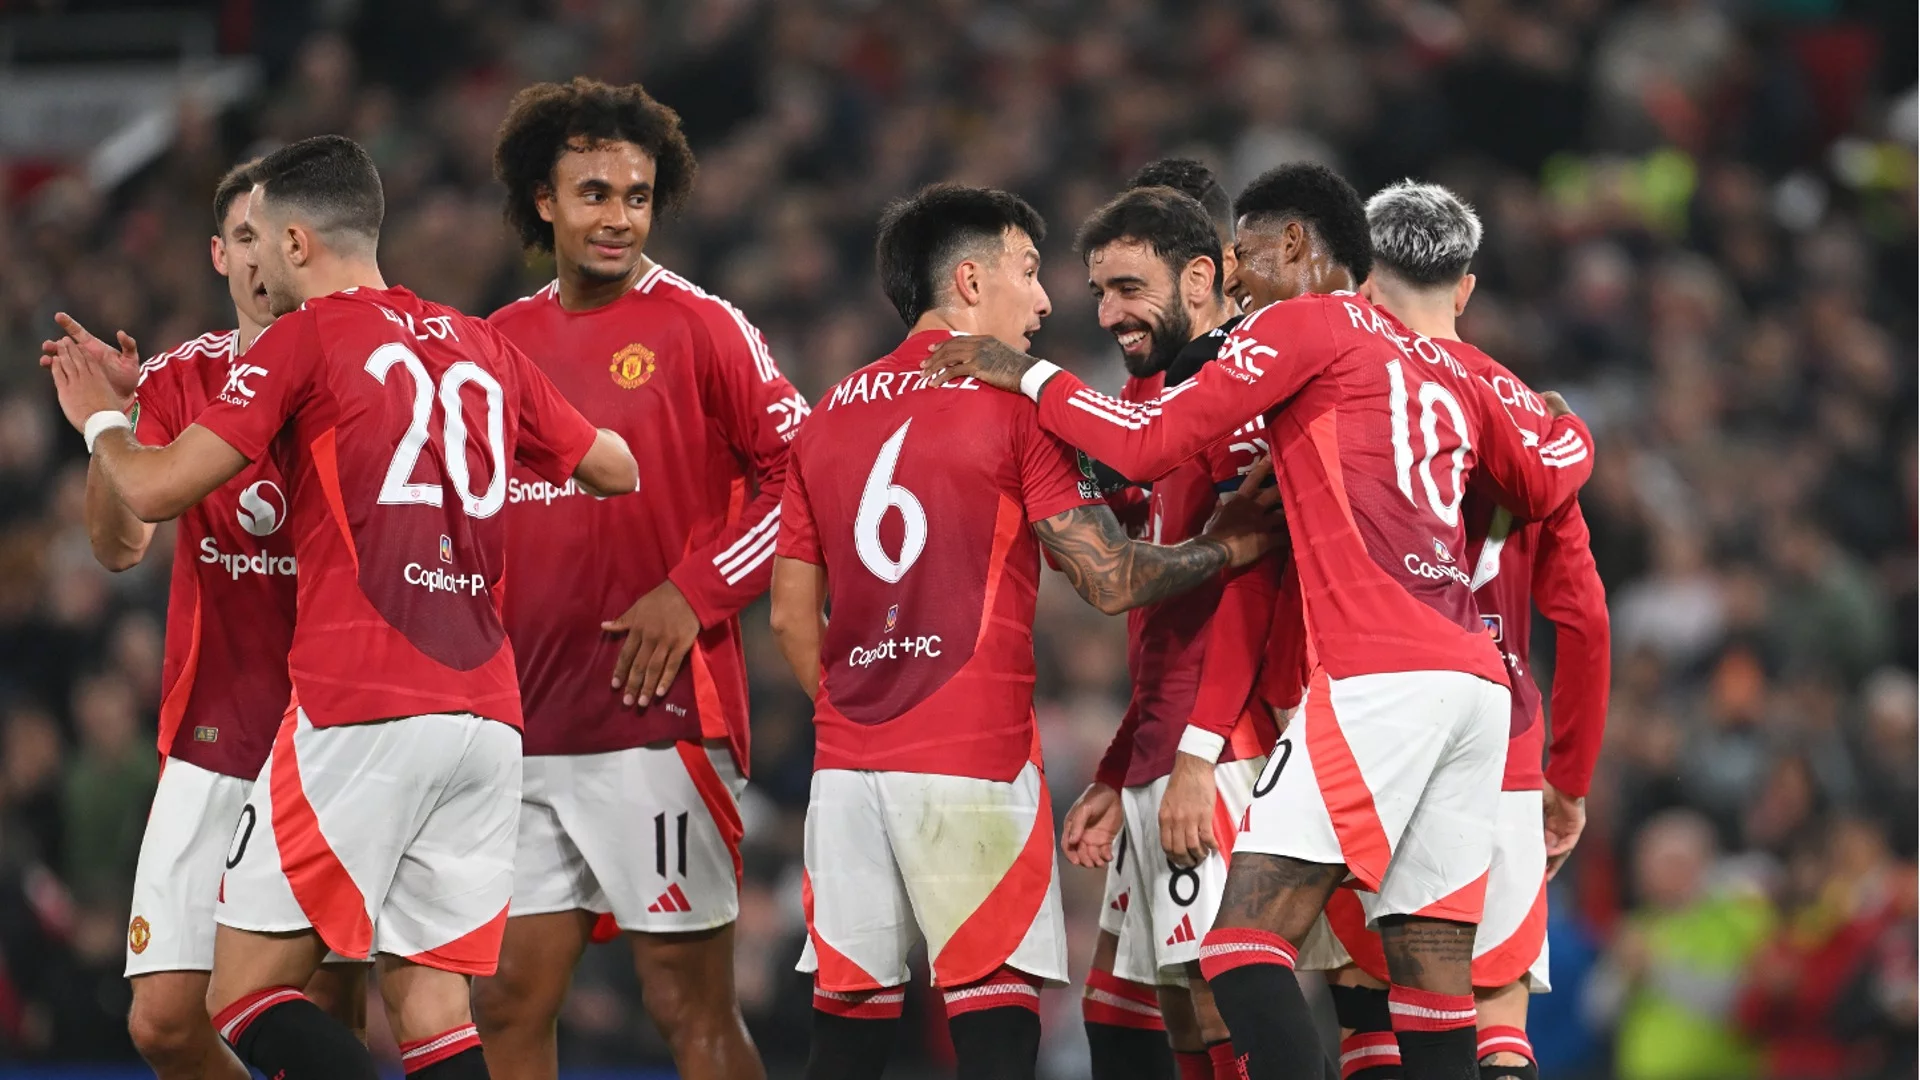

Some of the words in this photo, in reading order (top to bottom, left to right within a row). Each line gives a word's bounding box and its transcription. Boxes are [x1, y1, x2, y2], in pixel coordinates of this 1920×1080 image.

[364, 342, 507, 520] 20
[854, 415, 928, 584] 6
[1385, 358, 1472, 528] 10
[653, 810, 689, 880] 11
